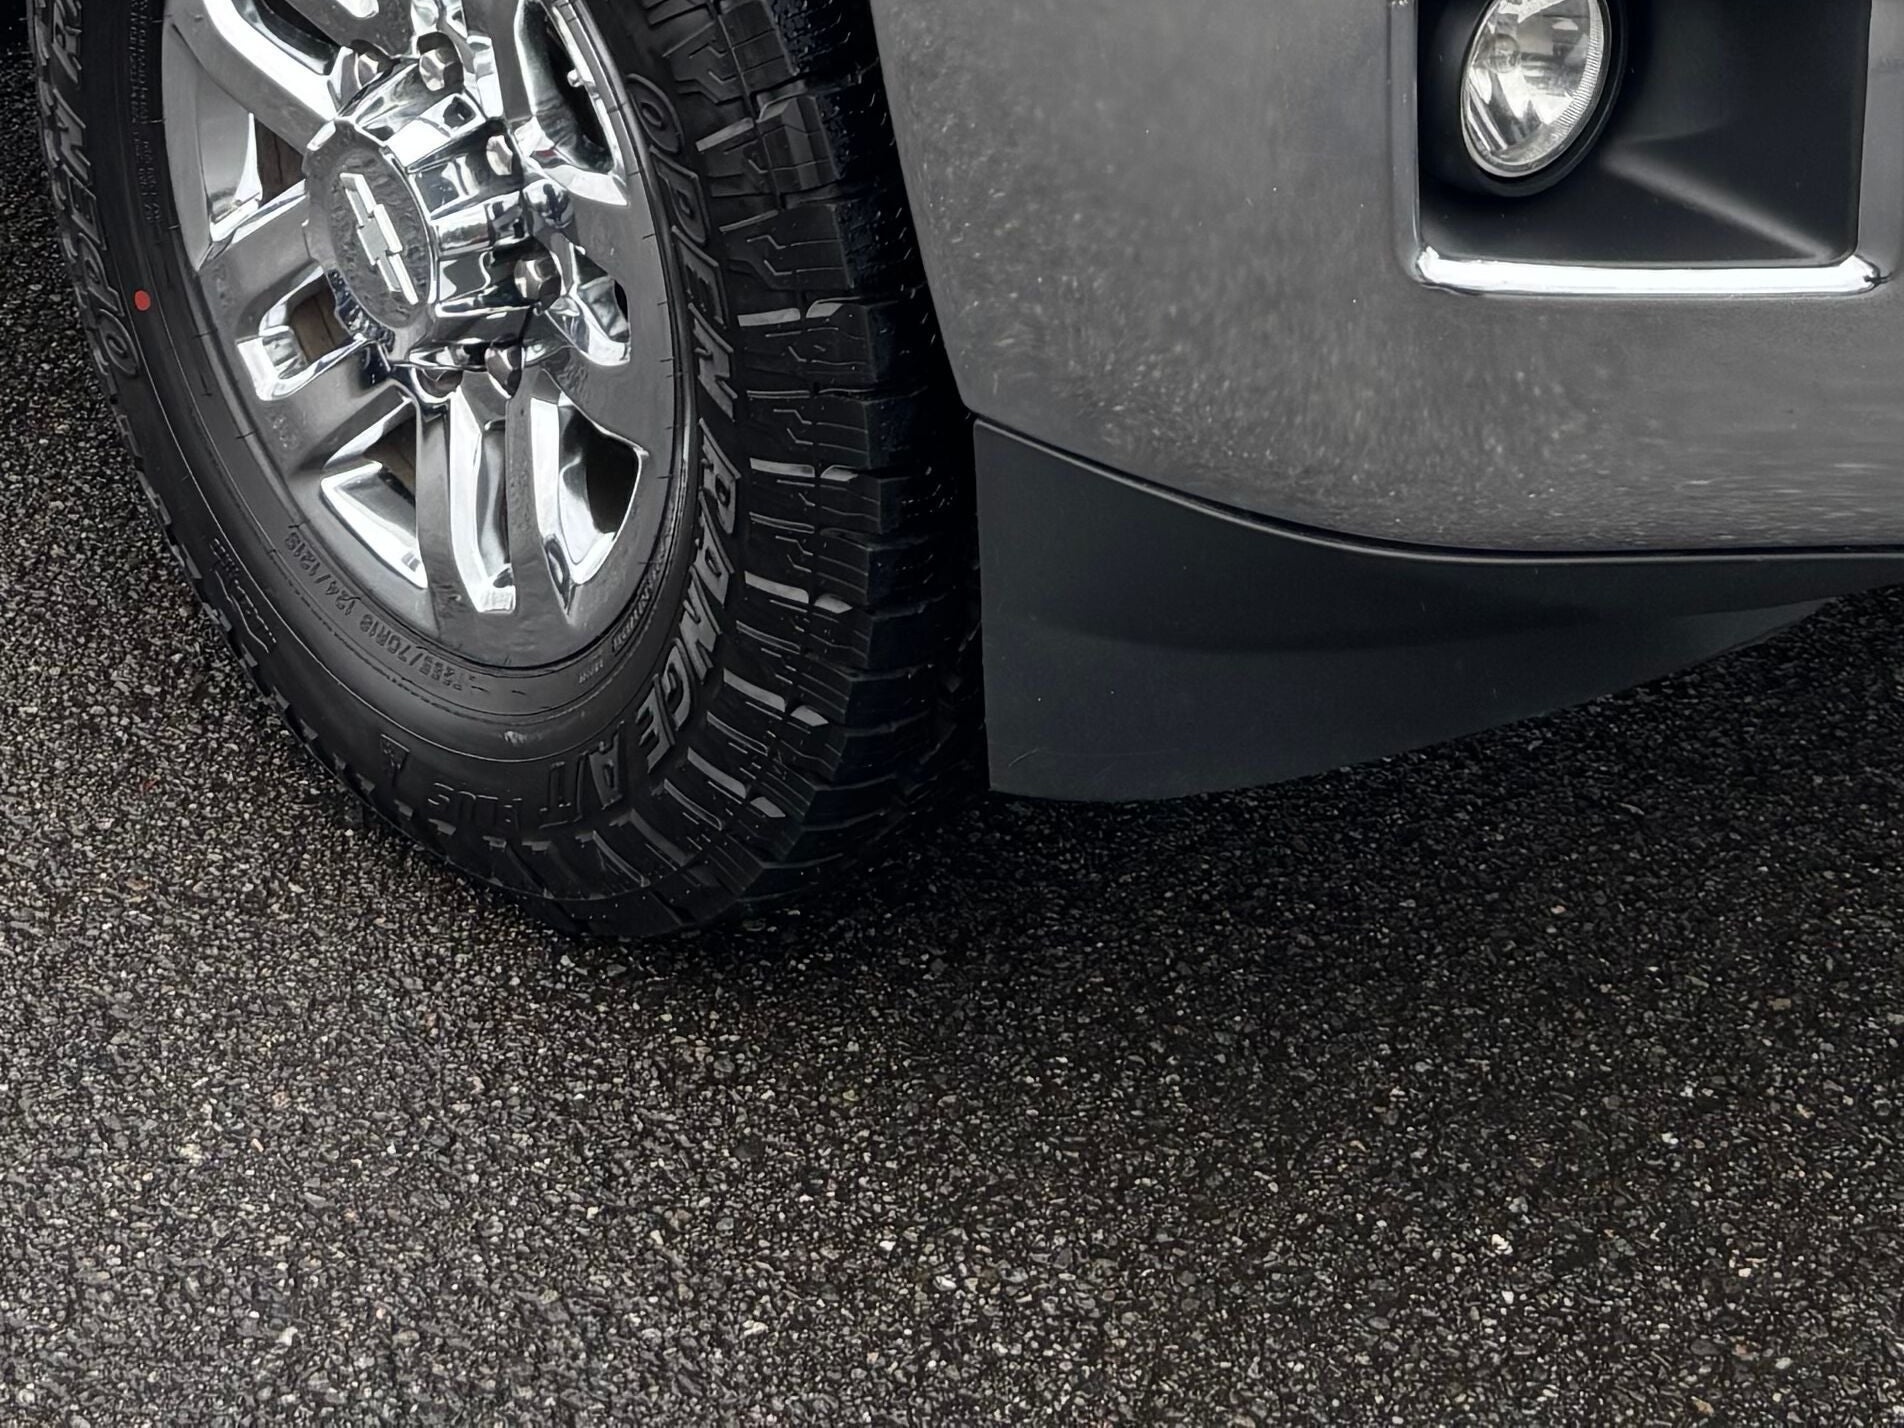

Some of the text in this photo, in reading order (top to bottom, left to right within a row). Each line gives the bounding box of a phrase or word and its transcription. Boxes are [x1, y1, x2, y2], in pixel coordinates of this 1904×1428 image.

[51, 86, 142, 378] OPEN
[626, 72, 738, 423] OPEN
[634, 418, 742, 775] RANGE
